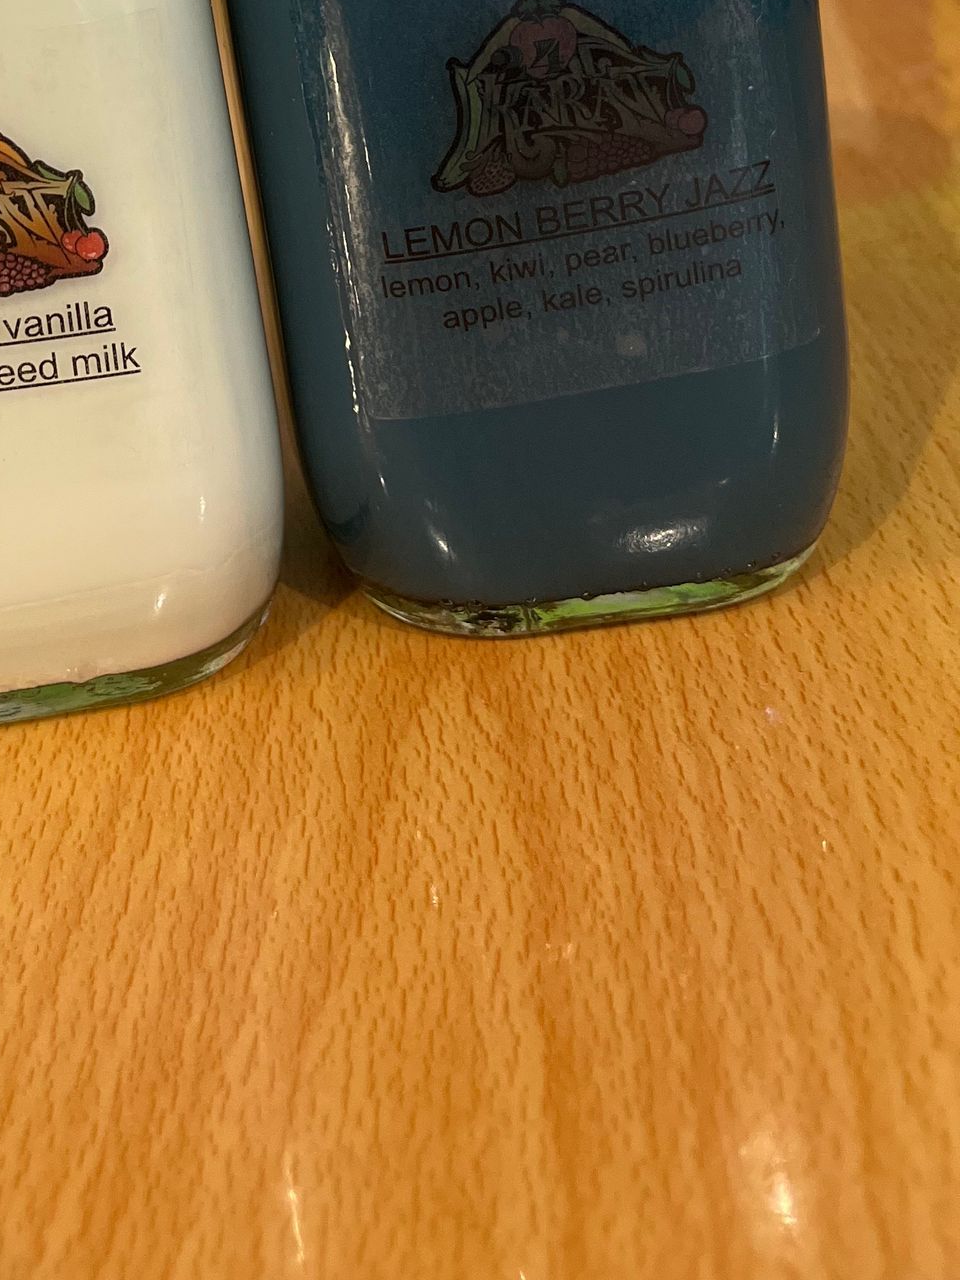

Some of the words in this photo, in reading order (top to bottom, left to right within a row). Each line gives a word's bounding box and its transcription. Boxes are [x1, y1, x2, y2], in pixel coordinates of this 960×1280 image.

[381, 211, 523, 260] LEMON
[534, 183, 668, 237] BERRY
[684, 160, 775, 208] JAZZ
[381, 272, 480, 299] lemon,
[490, 258, 555, 284] kiwi,
[566, 240, 638, 275] pear,
[648, 207, 786, 257] blueberry,
[3, 301, 114, 339] vanilla
[443, 297, 532, 331] apple,
[543, 282, 611, 314] kale,
[622, 258, 742, 301] spirulina
[71, 342, 141, 377] milk
